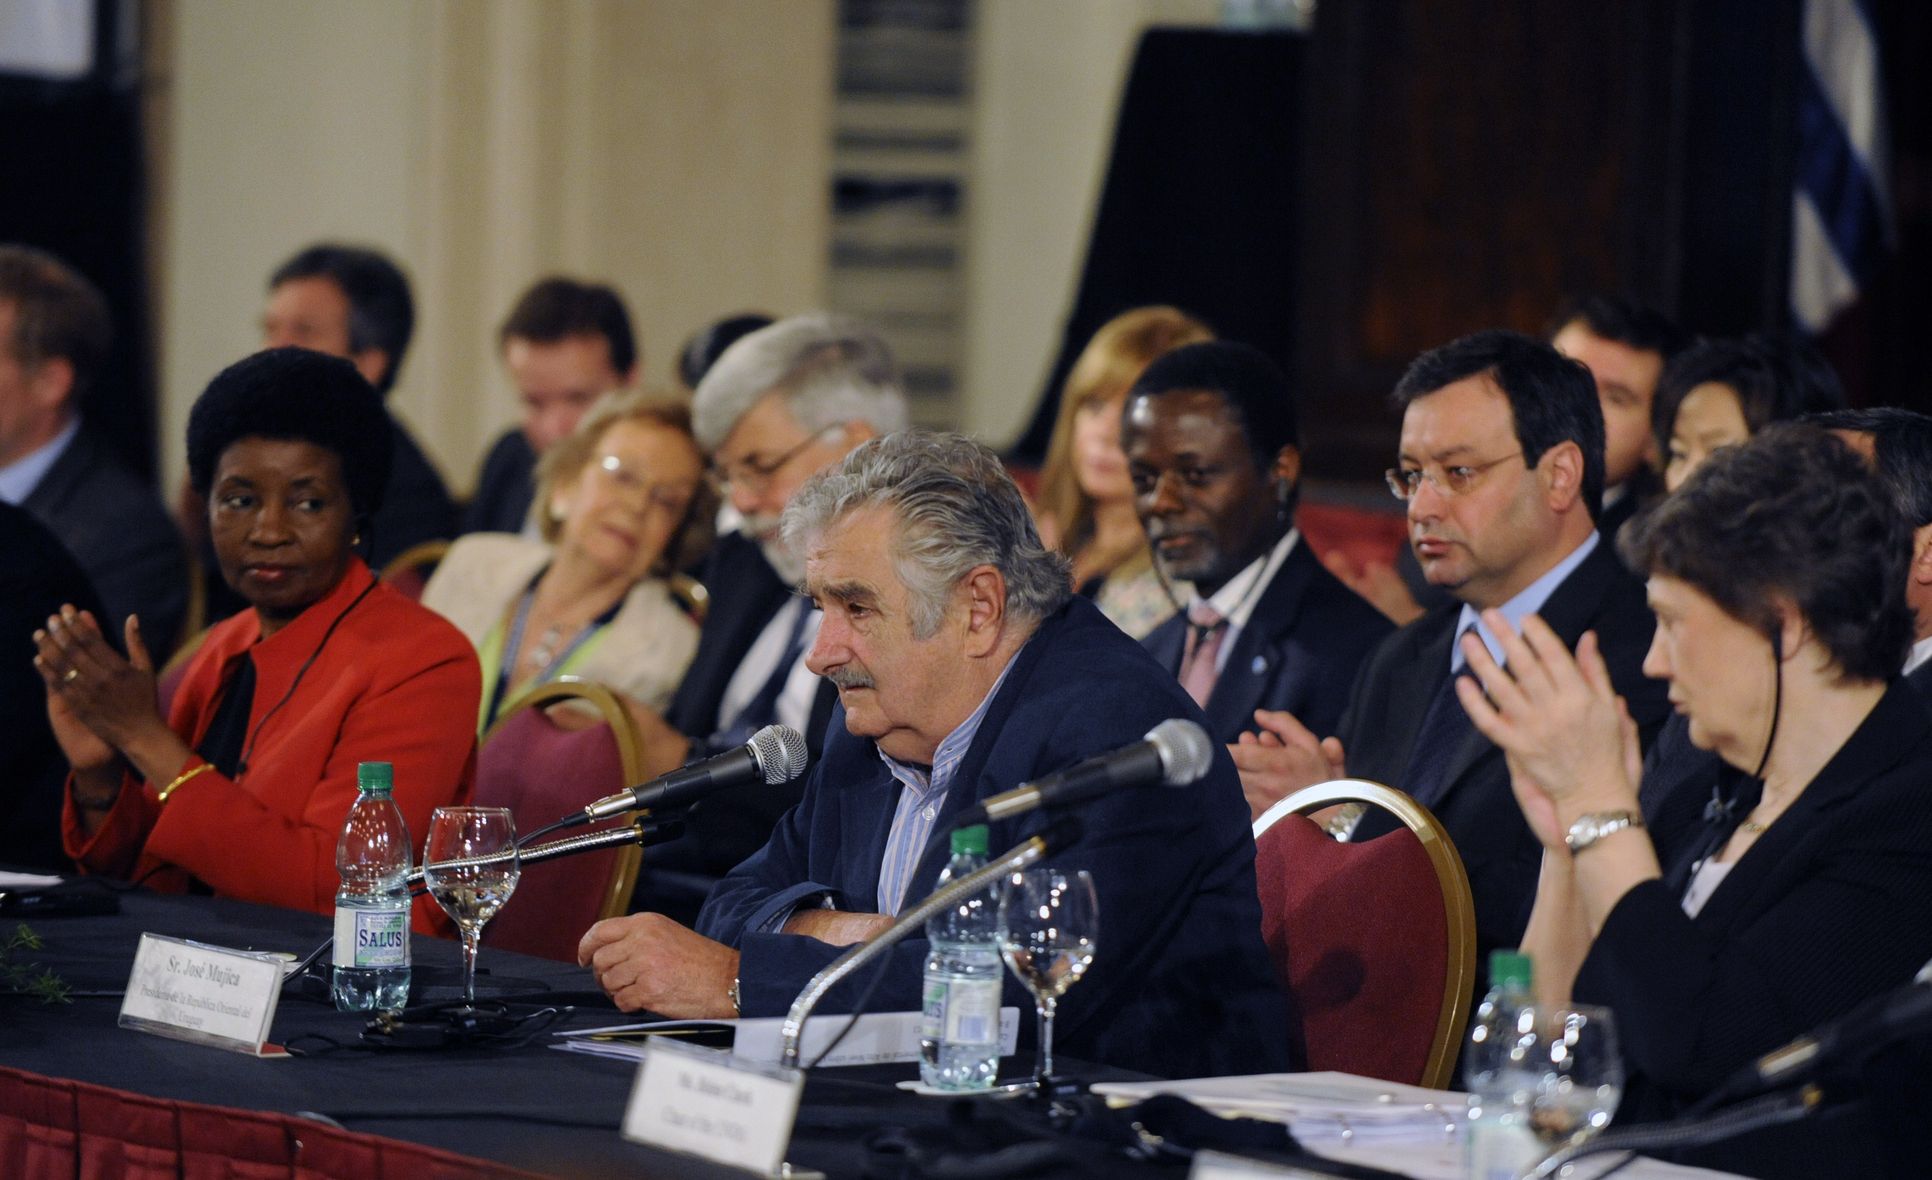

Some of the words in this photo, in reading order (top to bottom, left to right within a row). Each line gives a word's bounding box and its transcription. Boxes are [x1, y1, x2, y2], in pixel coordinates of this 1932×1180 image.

[359, 929, 402, 948] SALUS
[167, 955, 181, 974] Sr.
[183, 958, 206, 979] José
[207, 963, 240, 988] Mujica
